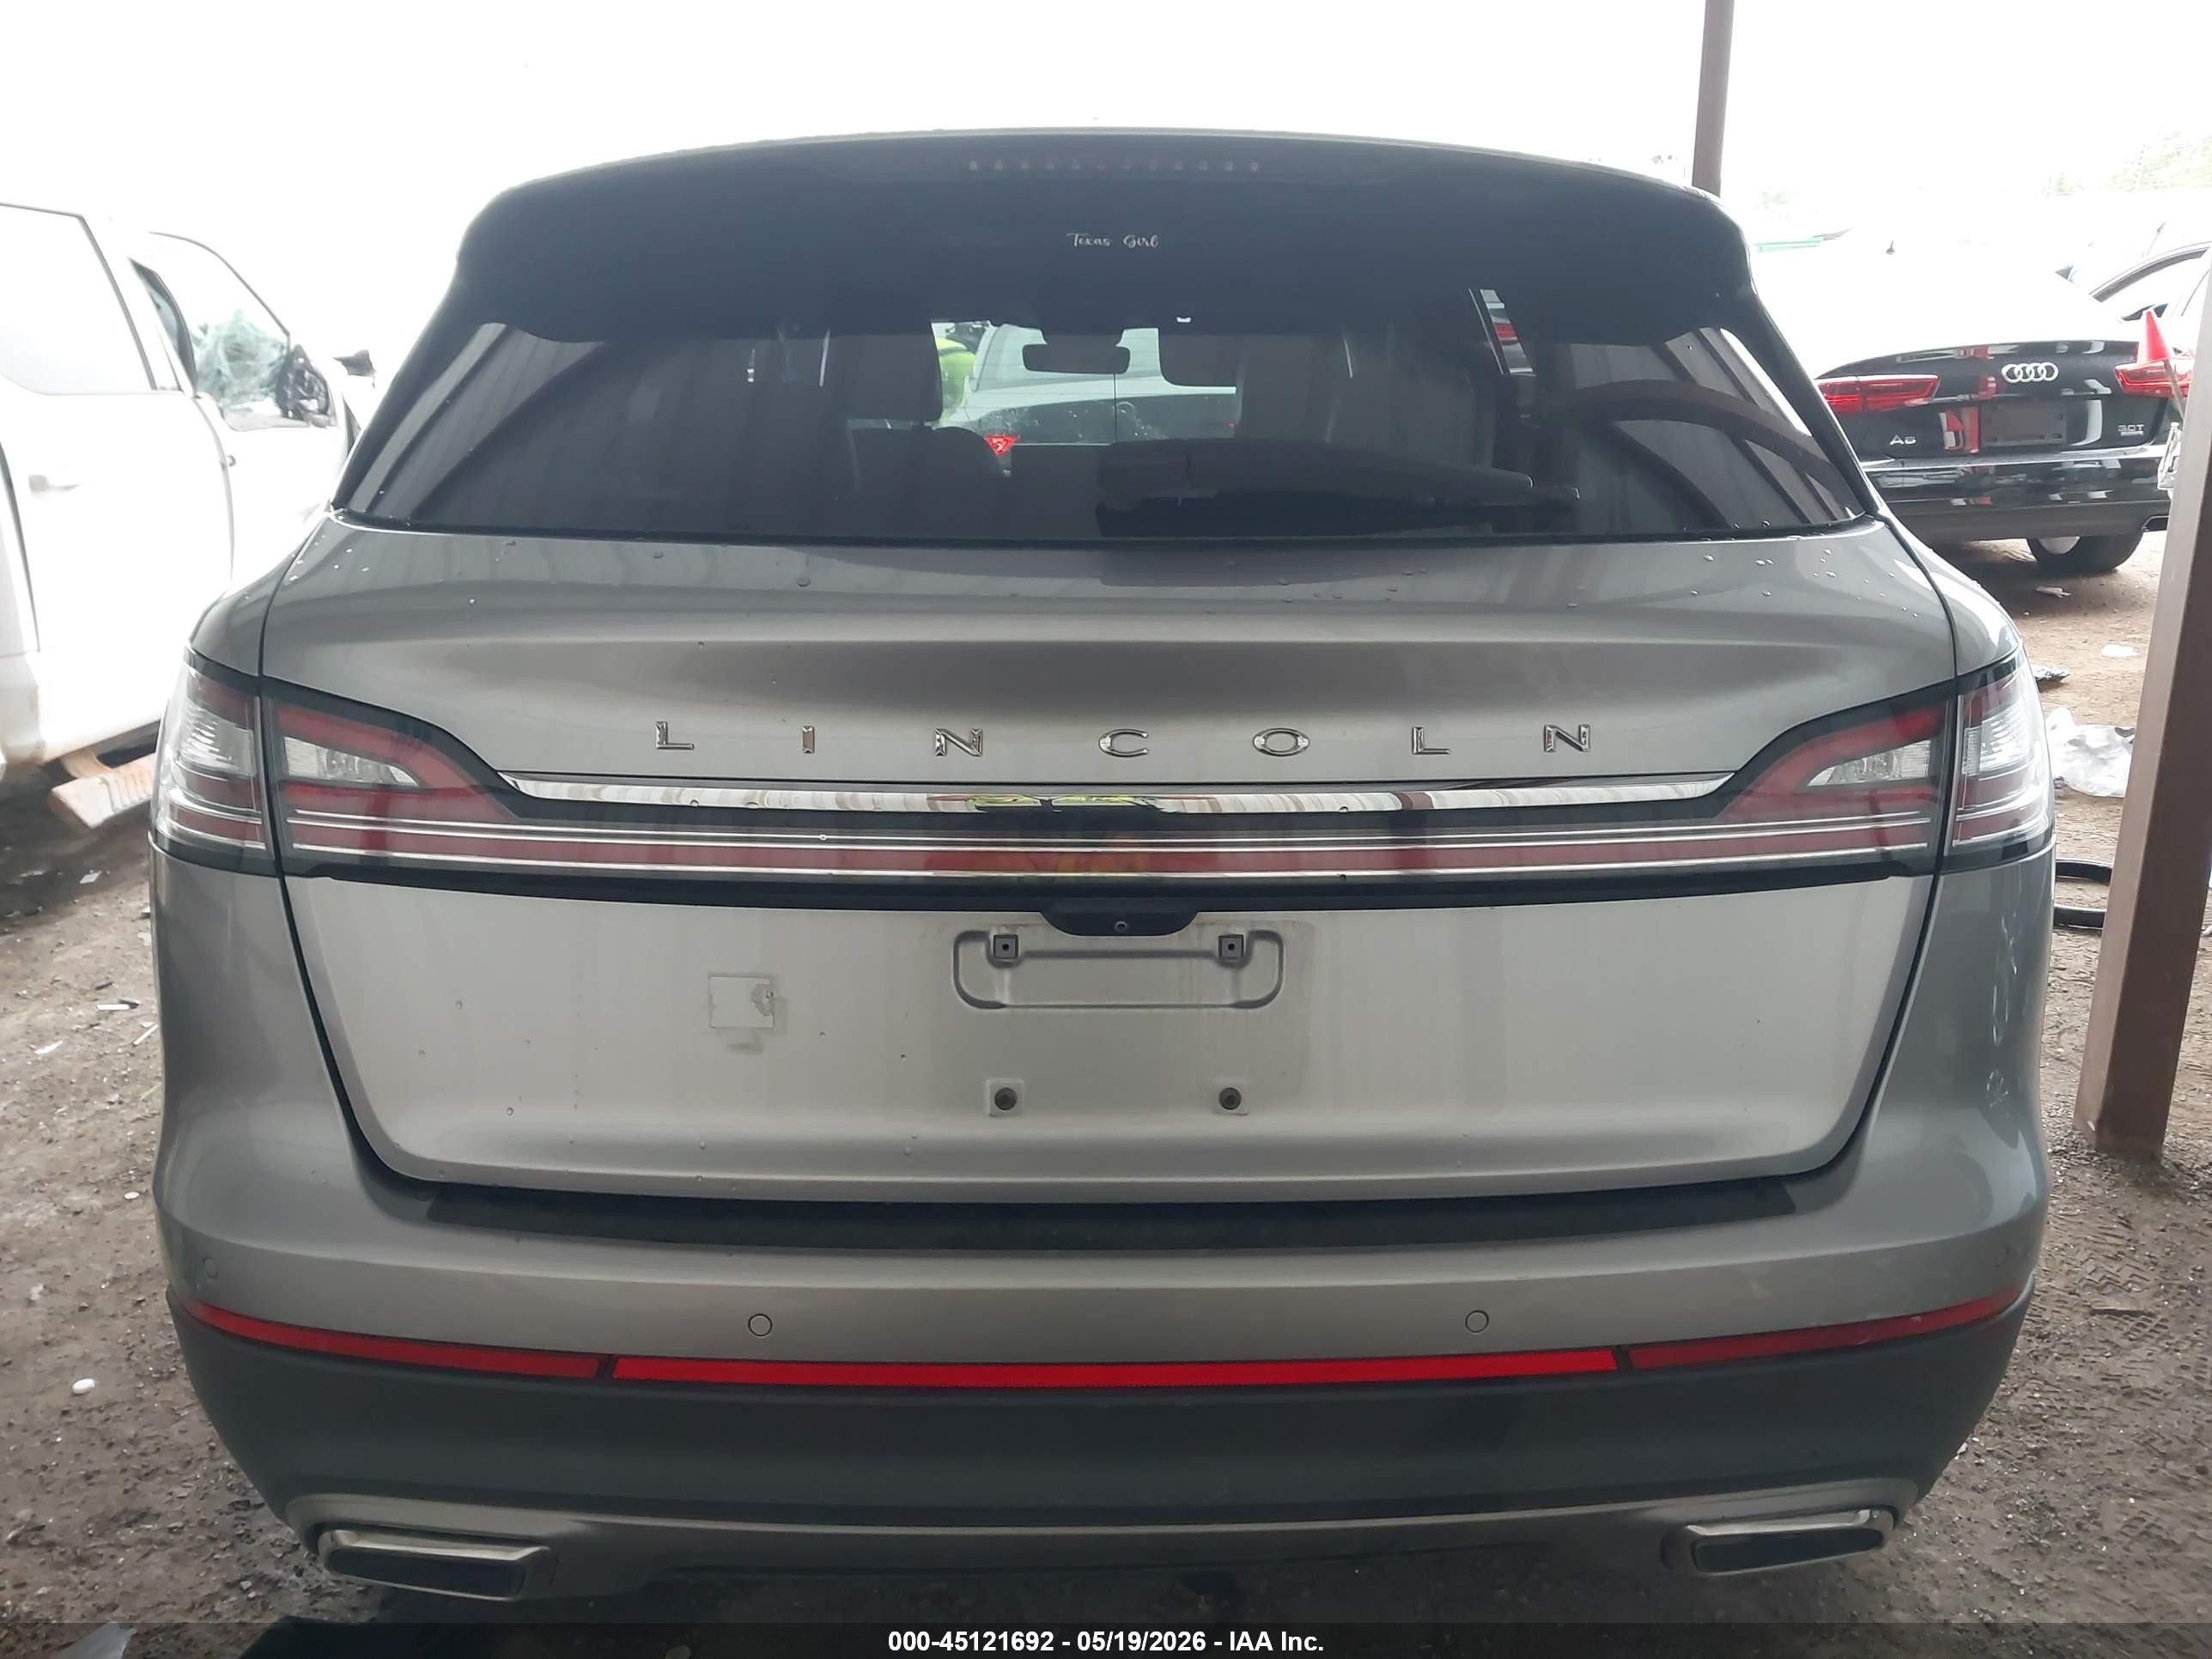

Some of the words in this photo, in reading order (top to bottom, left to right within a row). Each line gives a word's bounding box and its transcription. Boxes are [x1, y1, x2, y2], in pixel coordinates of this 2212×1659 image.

[1066, 233, 1111, 247] Texas
[1123, 234, 1159, 249] Girl
[655, 720, 1591, 757] LINCOLN
